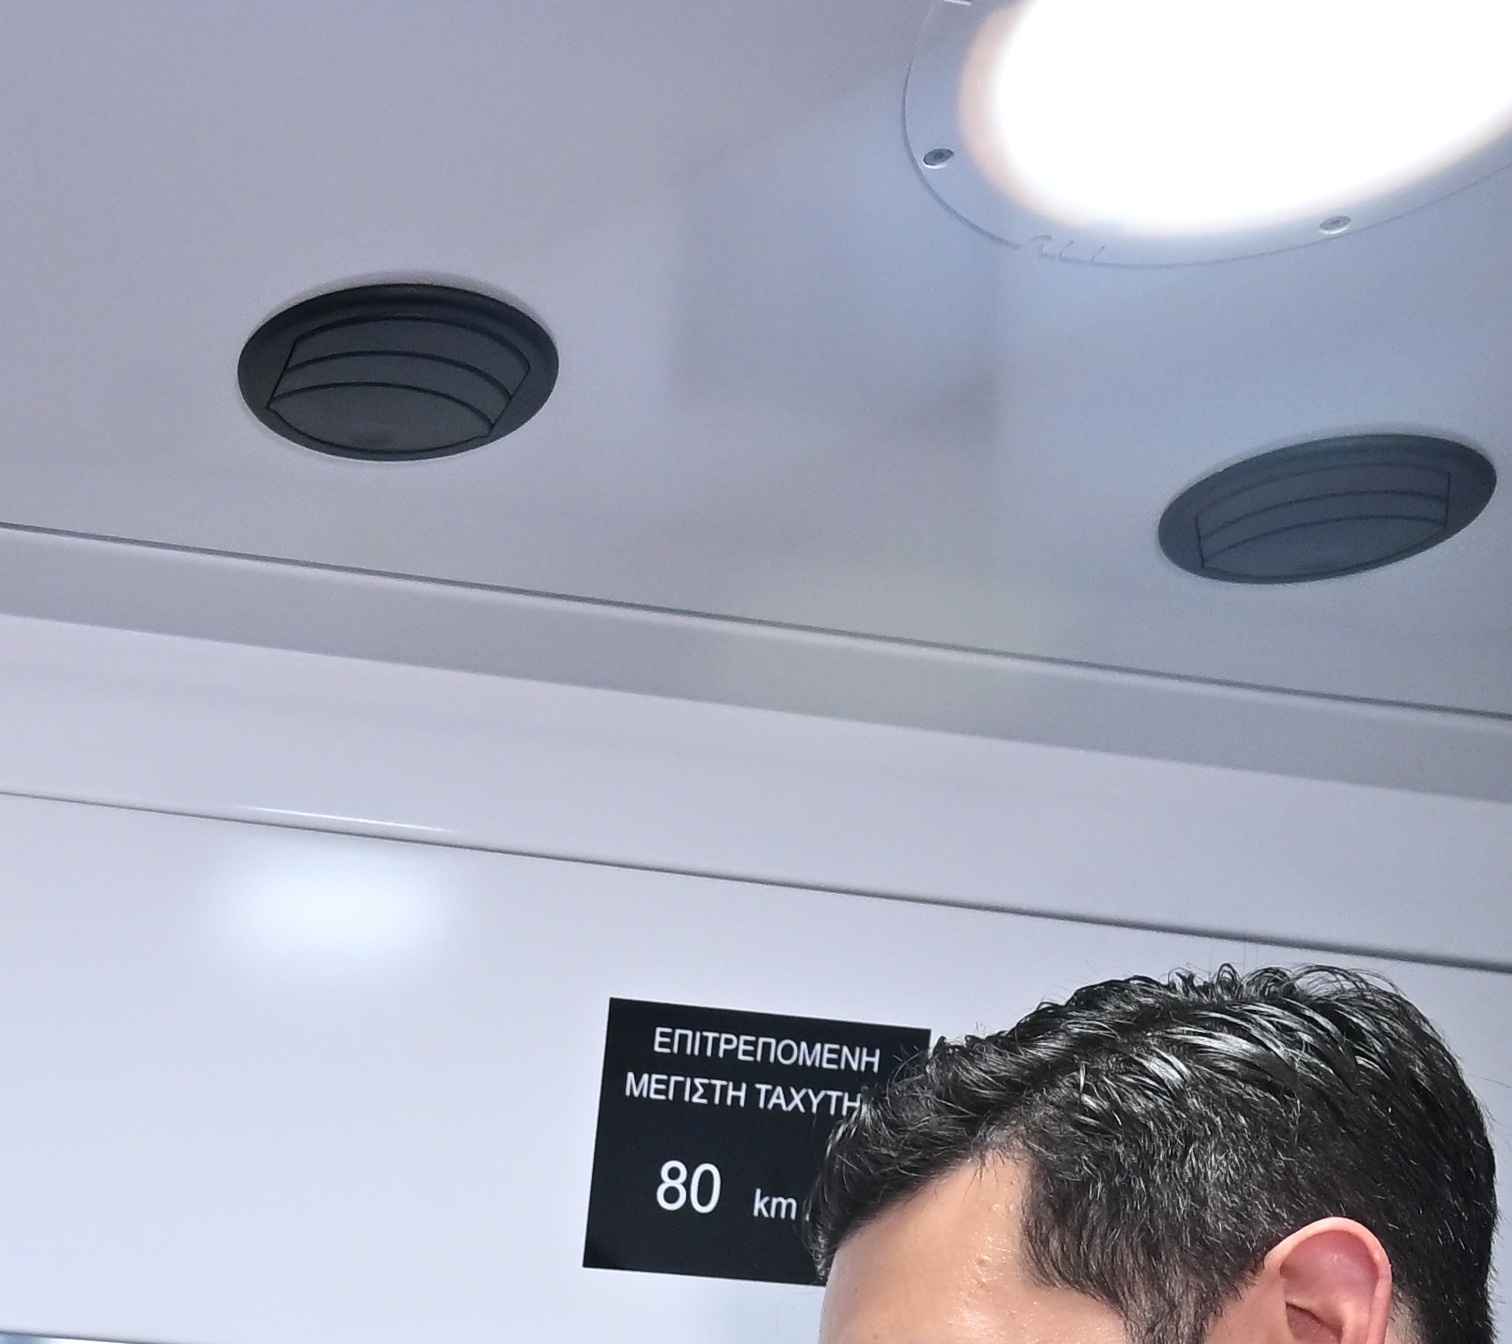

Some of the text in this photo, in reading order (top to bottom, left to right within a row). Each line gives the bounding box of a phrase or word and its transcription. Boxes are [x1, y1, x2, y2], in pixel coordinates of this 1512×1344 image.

[653, 1026, 881, 1074] ΕΠΙΤΡΕΠΟΜΕΝΗ
[625, 1071, 863, 1118] ΜΕΓΙΣΤΗ ΤΑΧΥΤΗ
[655, 1159, 800, 1221] 80 km
